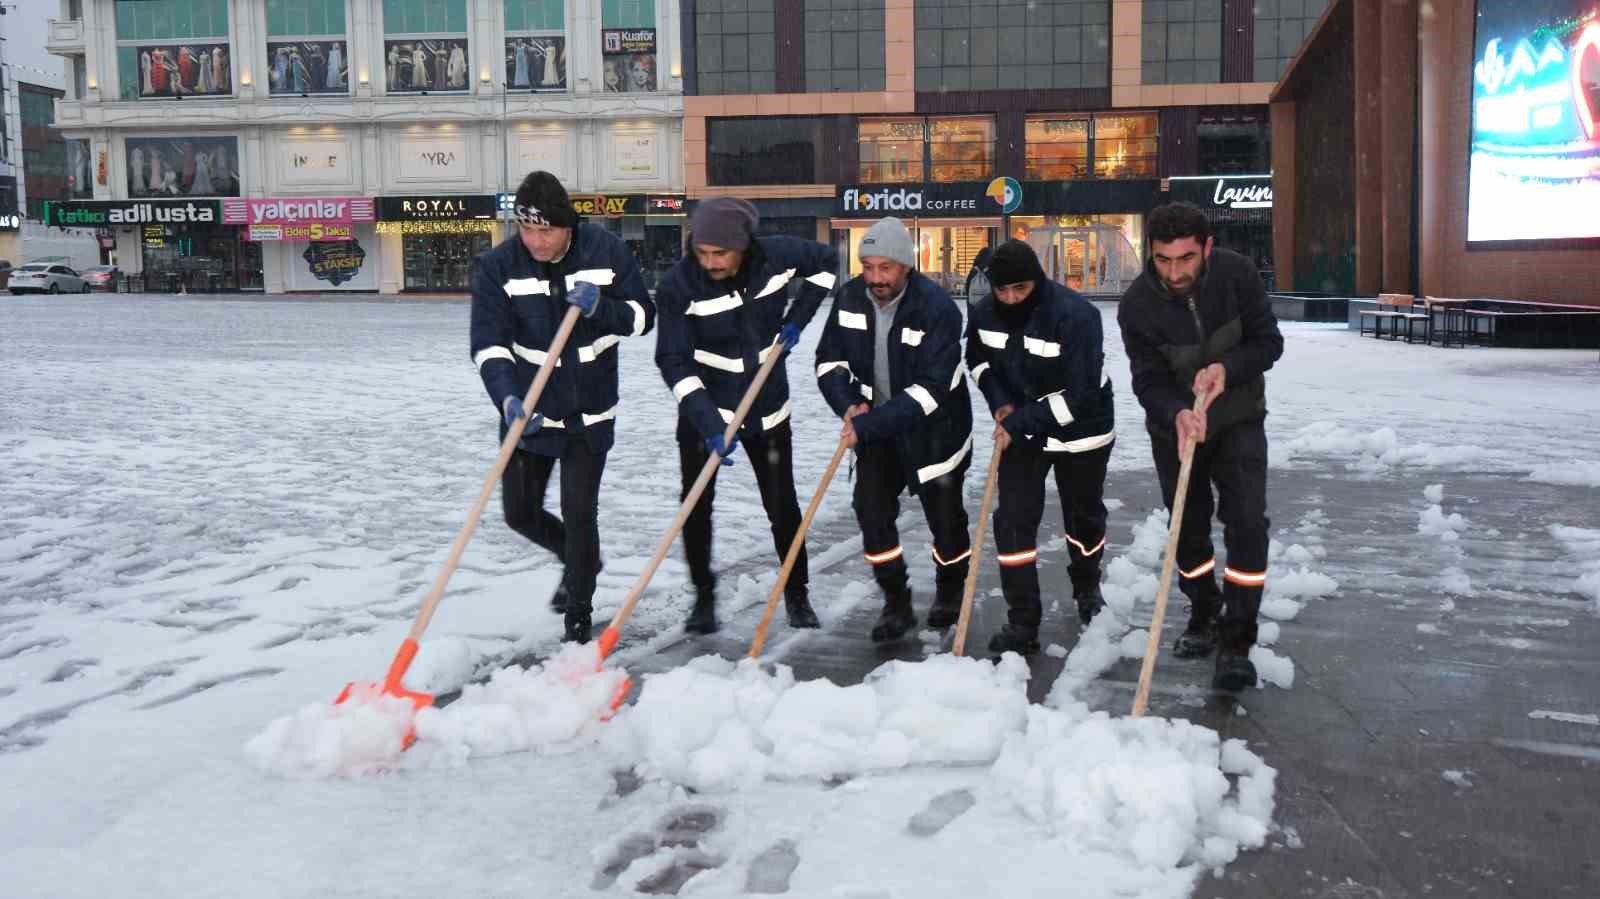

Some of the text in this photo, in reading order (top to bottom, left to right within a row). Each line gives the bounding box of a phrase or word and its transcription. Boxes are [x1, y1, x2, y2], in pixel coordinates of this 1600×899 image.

[403, 200, 466, 211] ROYAL
[844, 188, 976, 211] florida COFFEE
[109, 203, 153, 222] adil
[155, 202, 214, 222] usta
[251, 199, 347, 223] yalçınlar
[310, 223, 324, 240] 5
